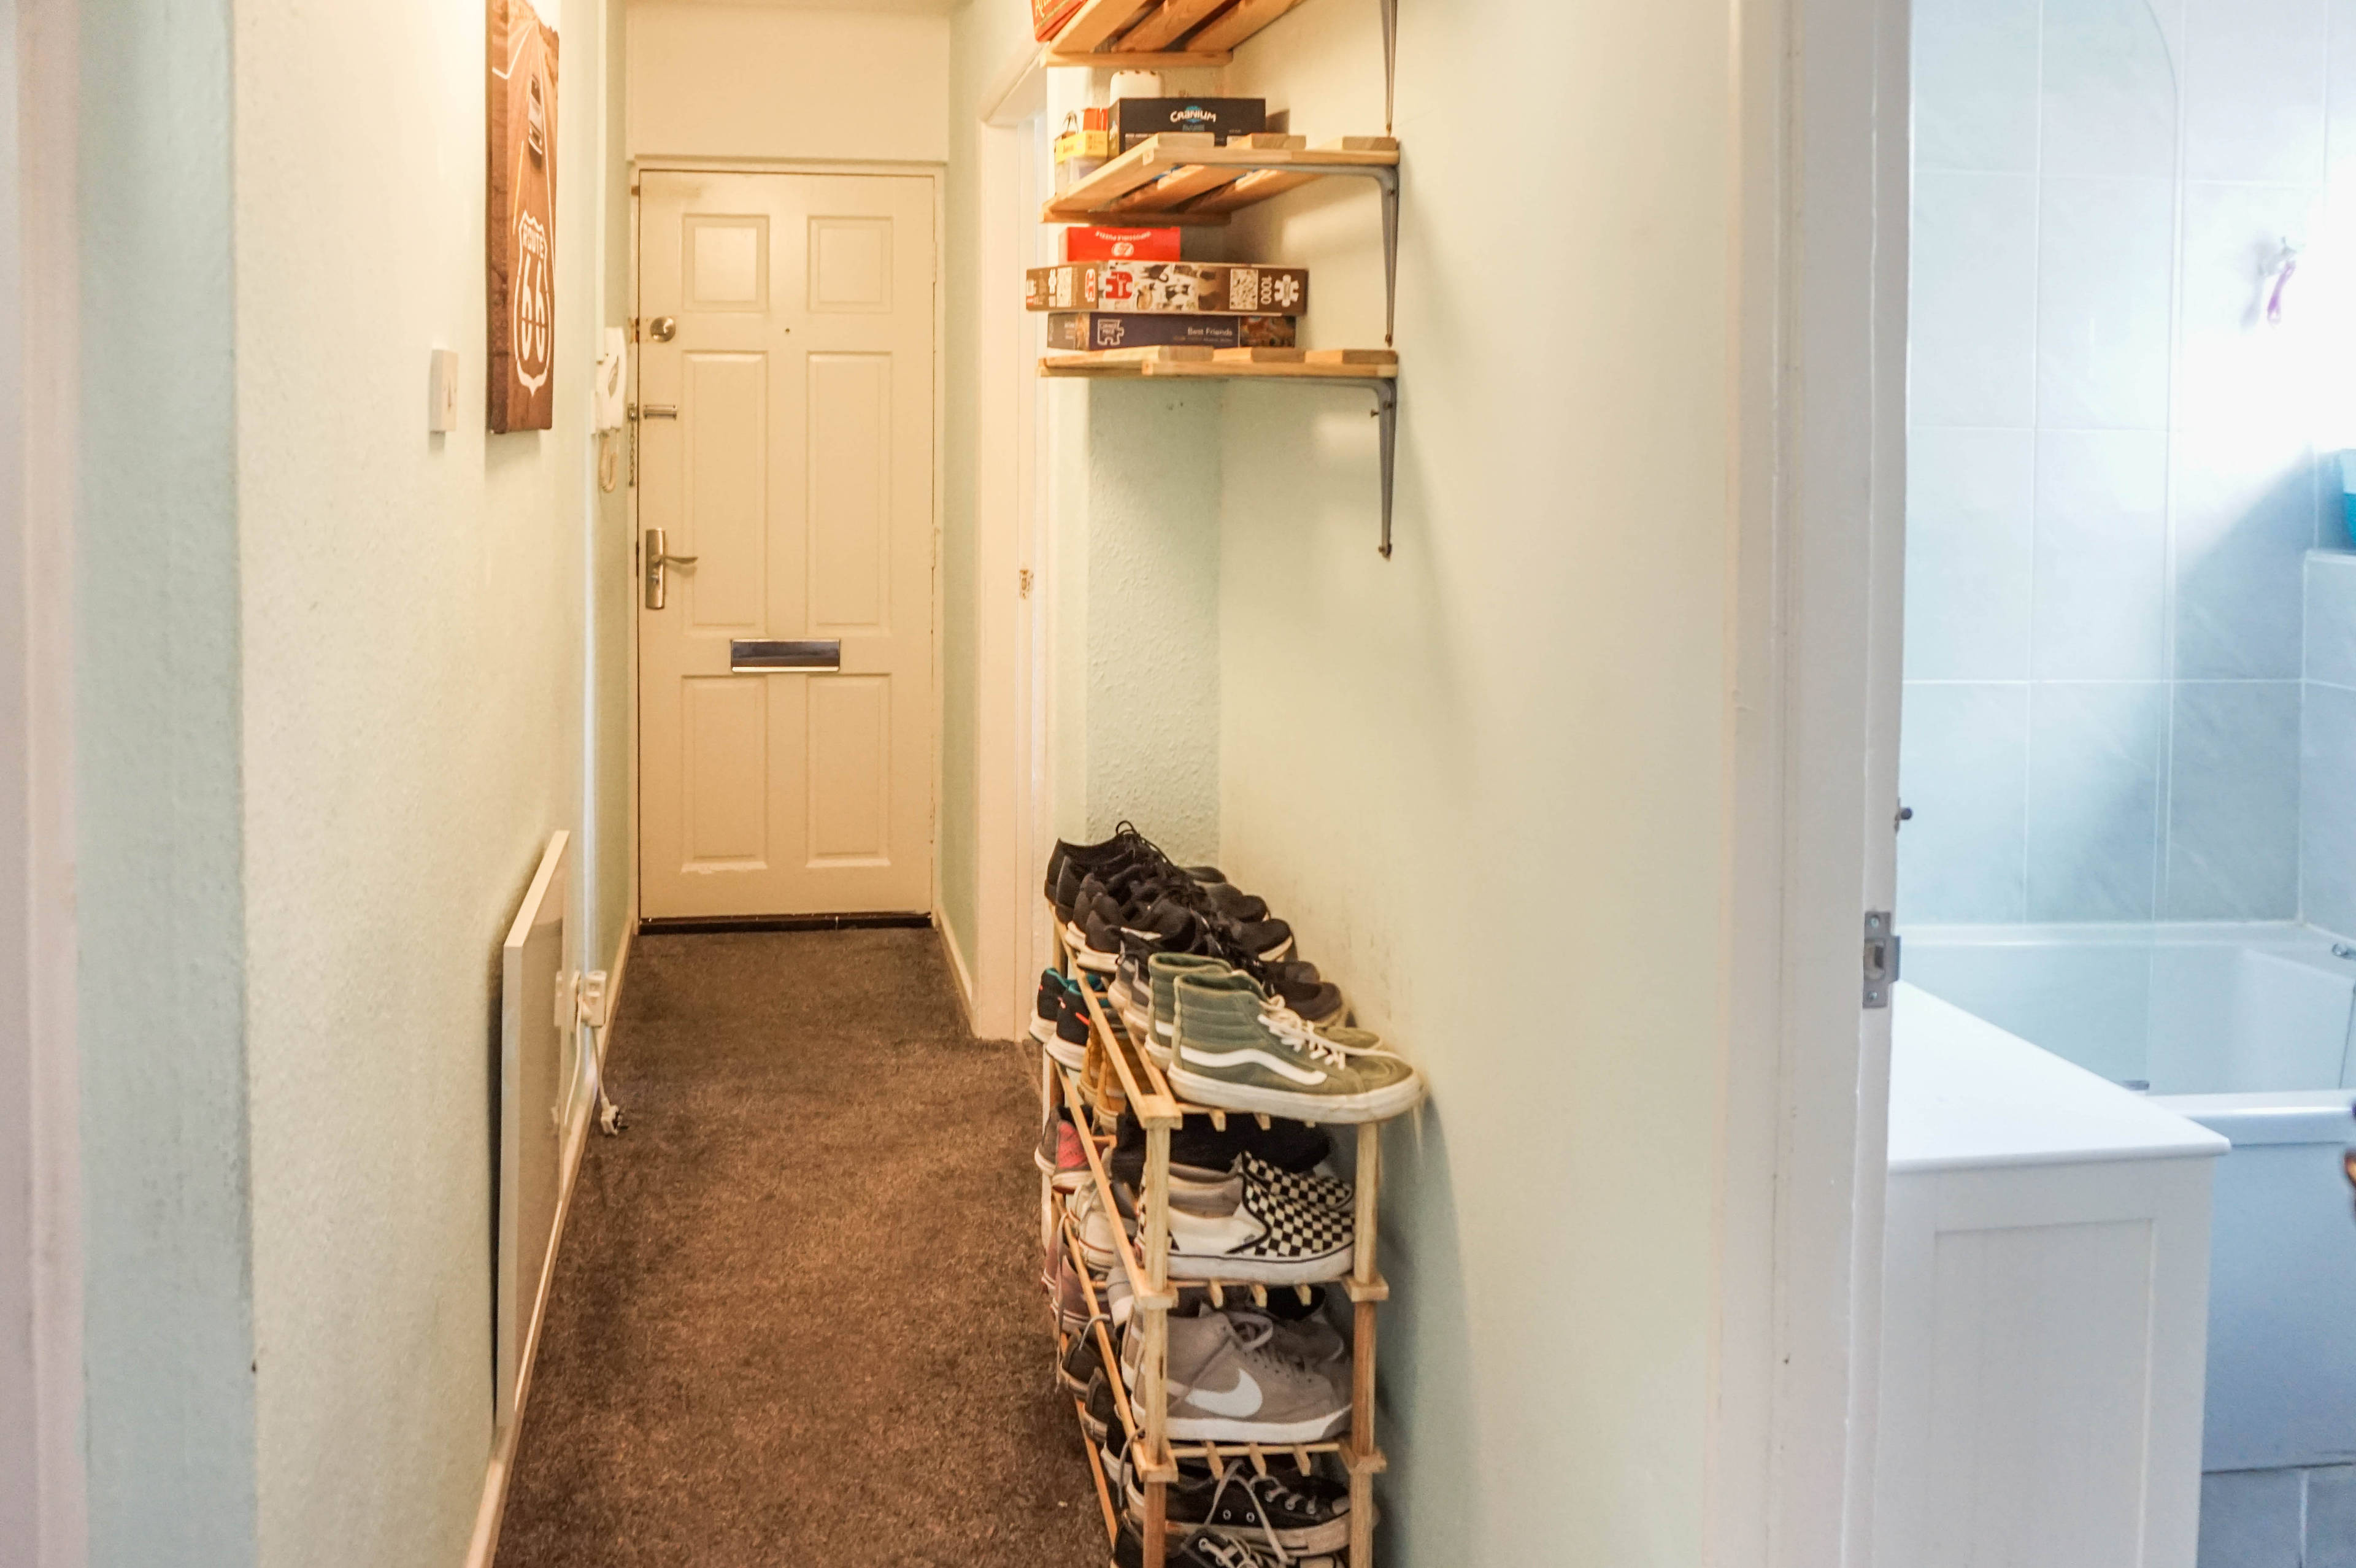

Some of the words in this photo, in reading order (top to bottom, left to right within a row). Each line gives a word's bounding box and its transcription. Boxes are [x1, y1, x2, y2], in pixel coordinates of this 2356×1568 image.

[523, 223, 544, 259] ROUTE
[1261, 275, 1272, 305] 1000
[522, 252, 545, 363] 66
[1206, 326, 1233, 336] Friends
